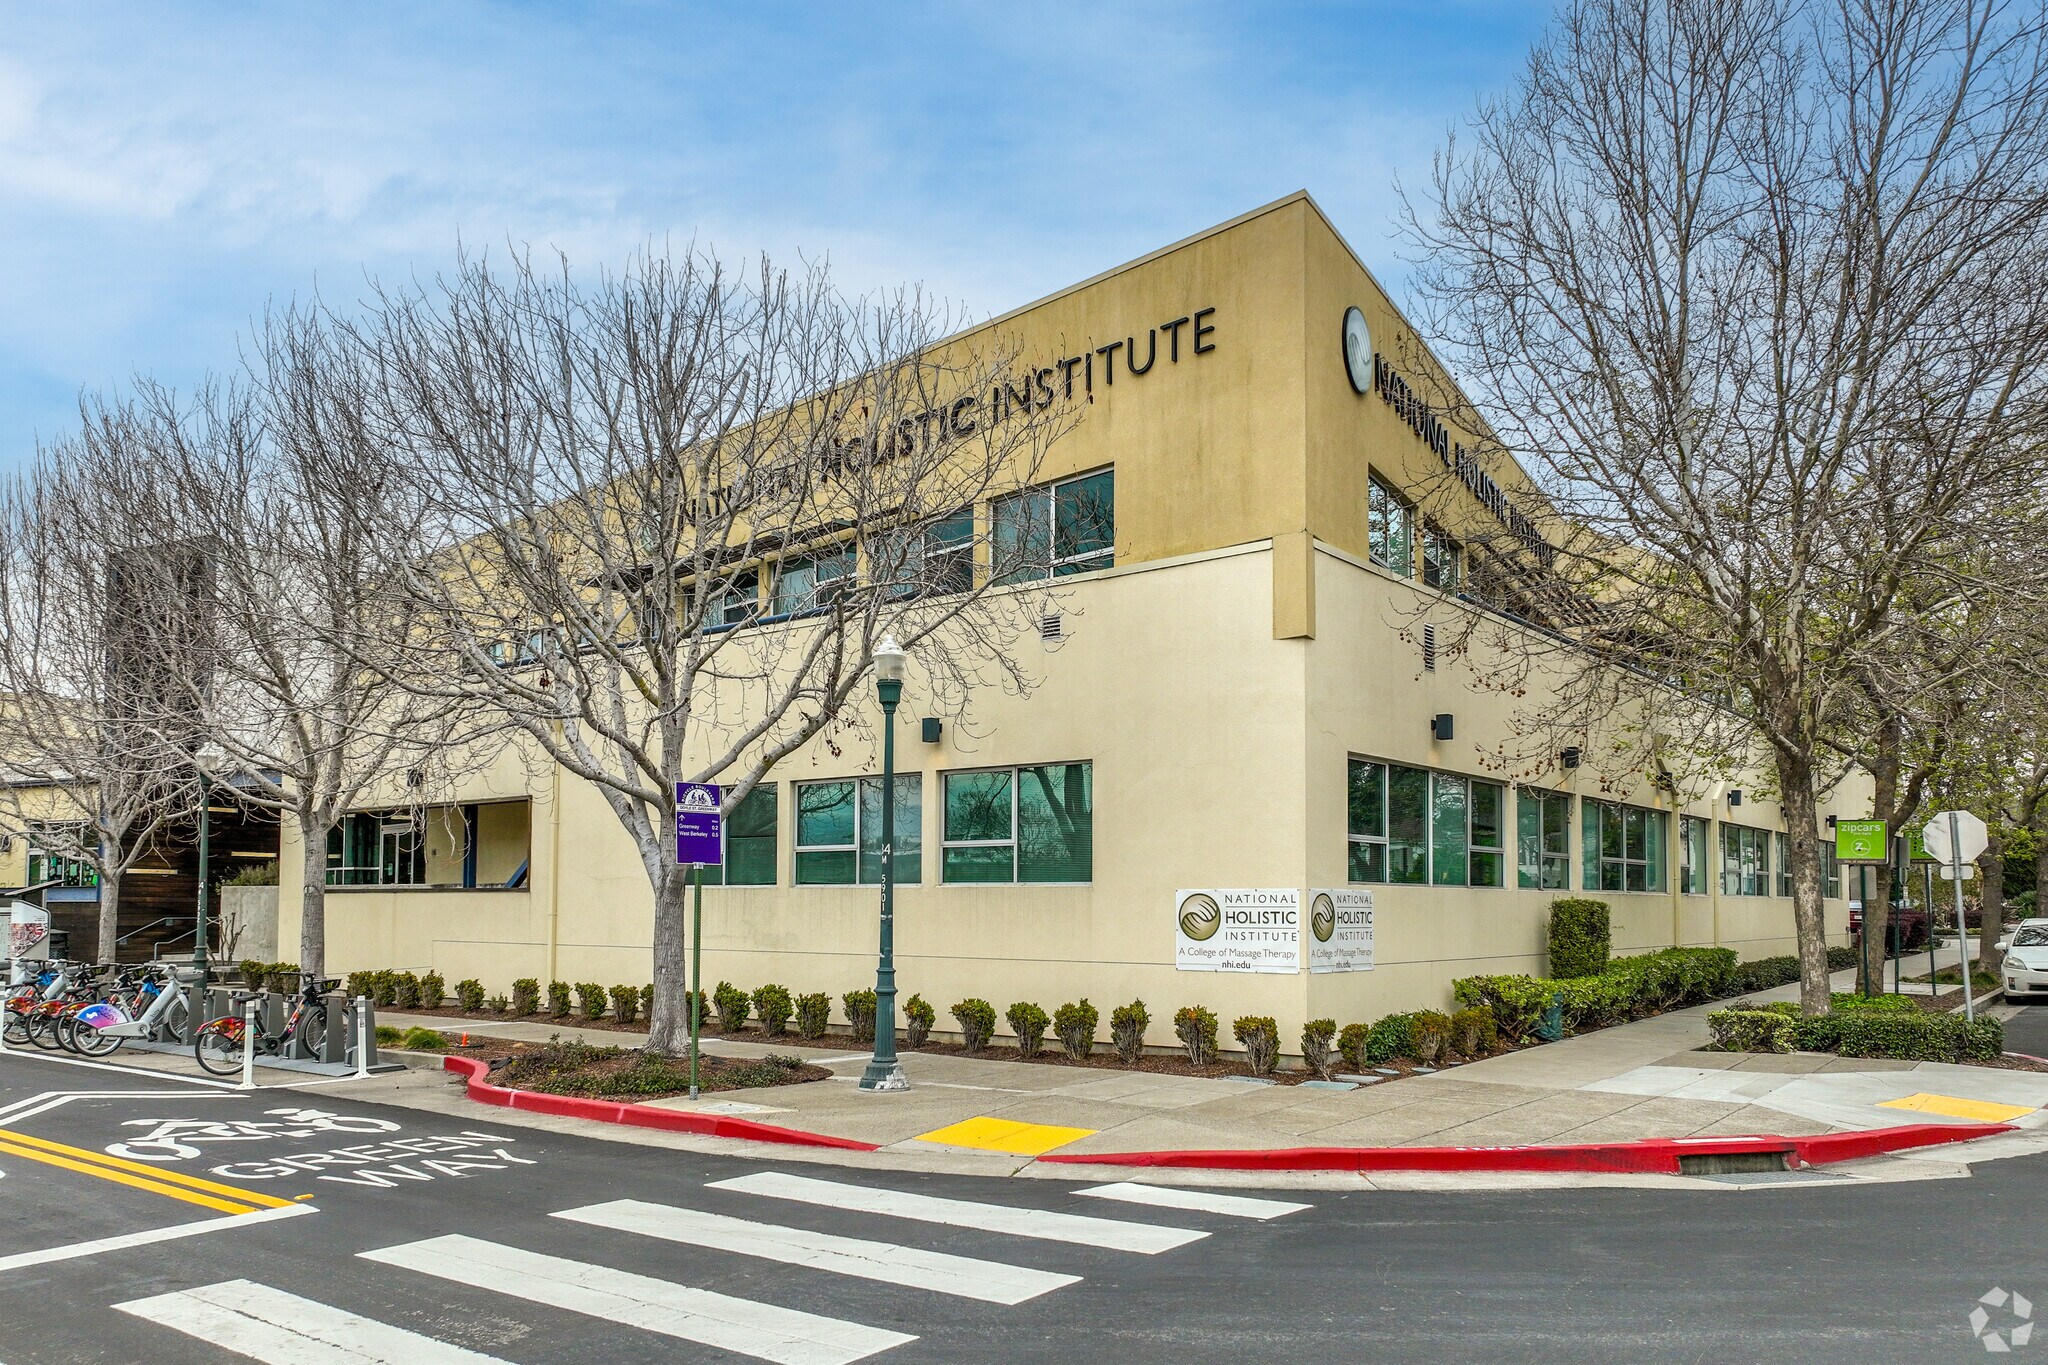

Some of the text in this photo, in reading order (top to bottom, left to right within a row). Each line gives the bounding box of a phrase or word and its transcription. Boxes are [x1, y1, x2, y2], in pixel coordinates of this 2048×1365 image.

[993, 306, 1216, 424] INSTITUTE
[1841, 822, 1881, 834] zipcars
[1225, 894, 1296, 904] NATIONAL
[1336, 894, 1372, 904] NATIONAL
[1225, 911, 1296, 924] HOLISTIC
[1337, 911, 1373, 924] HOLISTIC
[1225, 931, 1297, 942] INSTITUTE
[1337, 931, 1373, 941] INSTITUTE
[1179, 947, 1296, 960] A College of Massage Therapy
[1311, 947, 1372, 960] A College of Massage Therapy
[1221, 960, 1251, 969] nhi.edu
[1336, 960, 1351, 969] nhi.edu
[211, 1131, 516, 1179] GREEN
[317, 1148, 538, 1188] WAY
